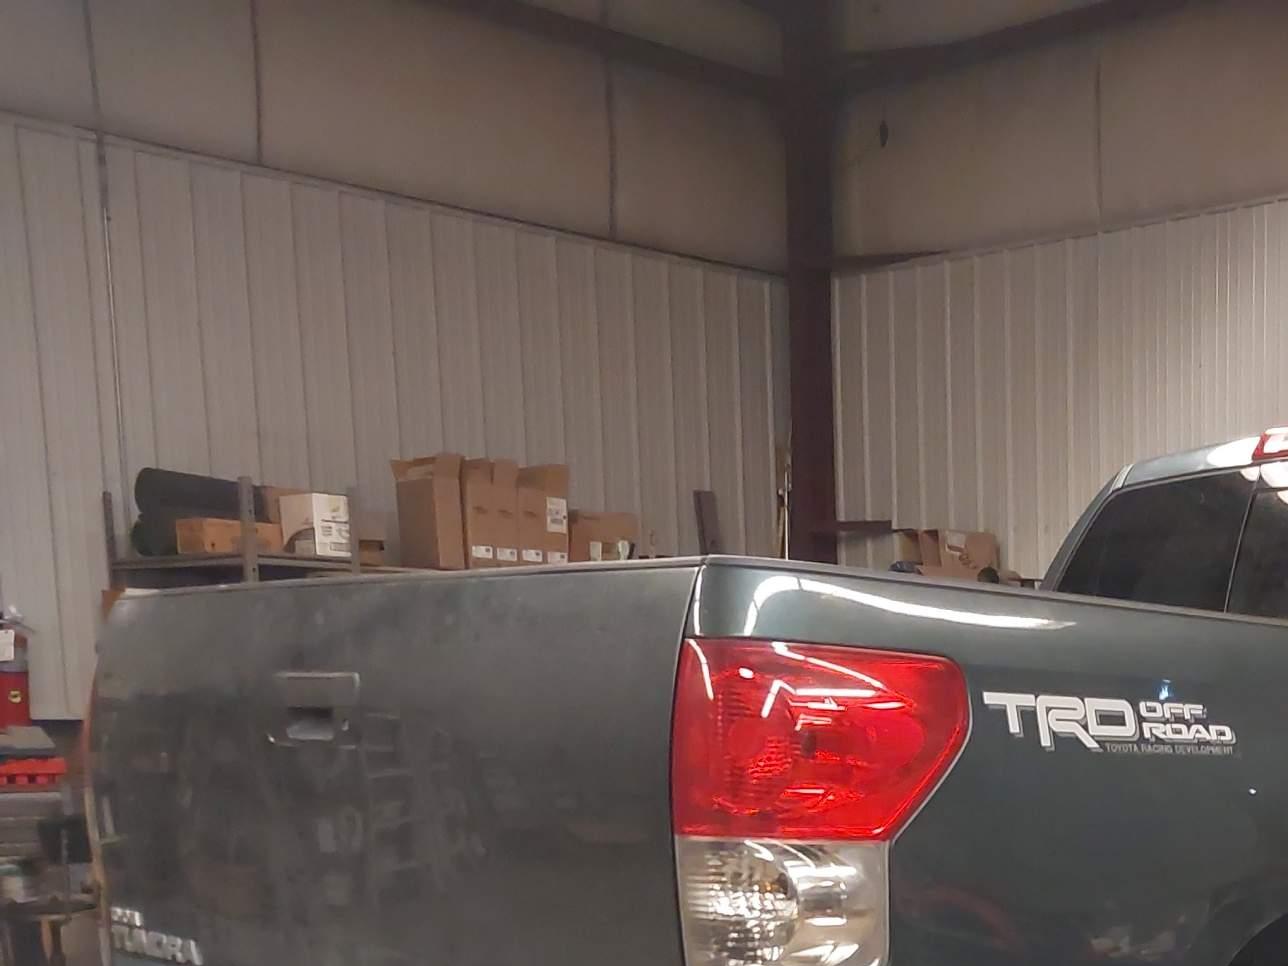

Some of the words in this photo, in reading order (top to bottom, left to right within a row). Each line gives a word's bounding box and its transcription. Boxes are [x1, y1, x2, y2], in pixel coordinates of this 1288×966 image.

[982, 691, 1140, 752] TRD
[1139, 700, 1207, 722] OFF
[1142, 721, 1237, 745] ROAD
